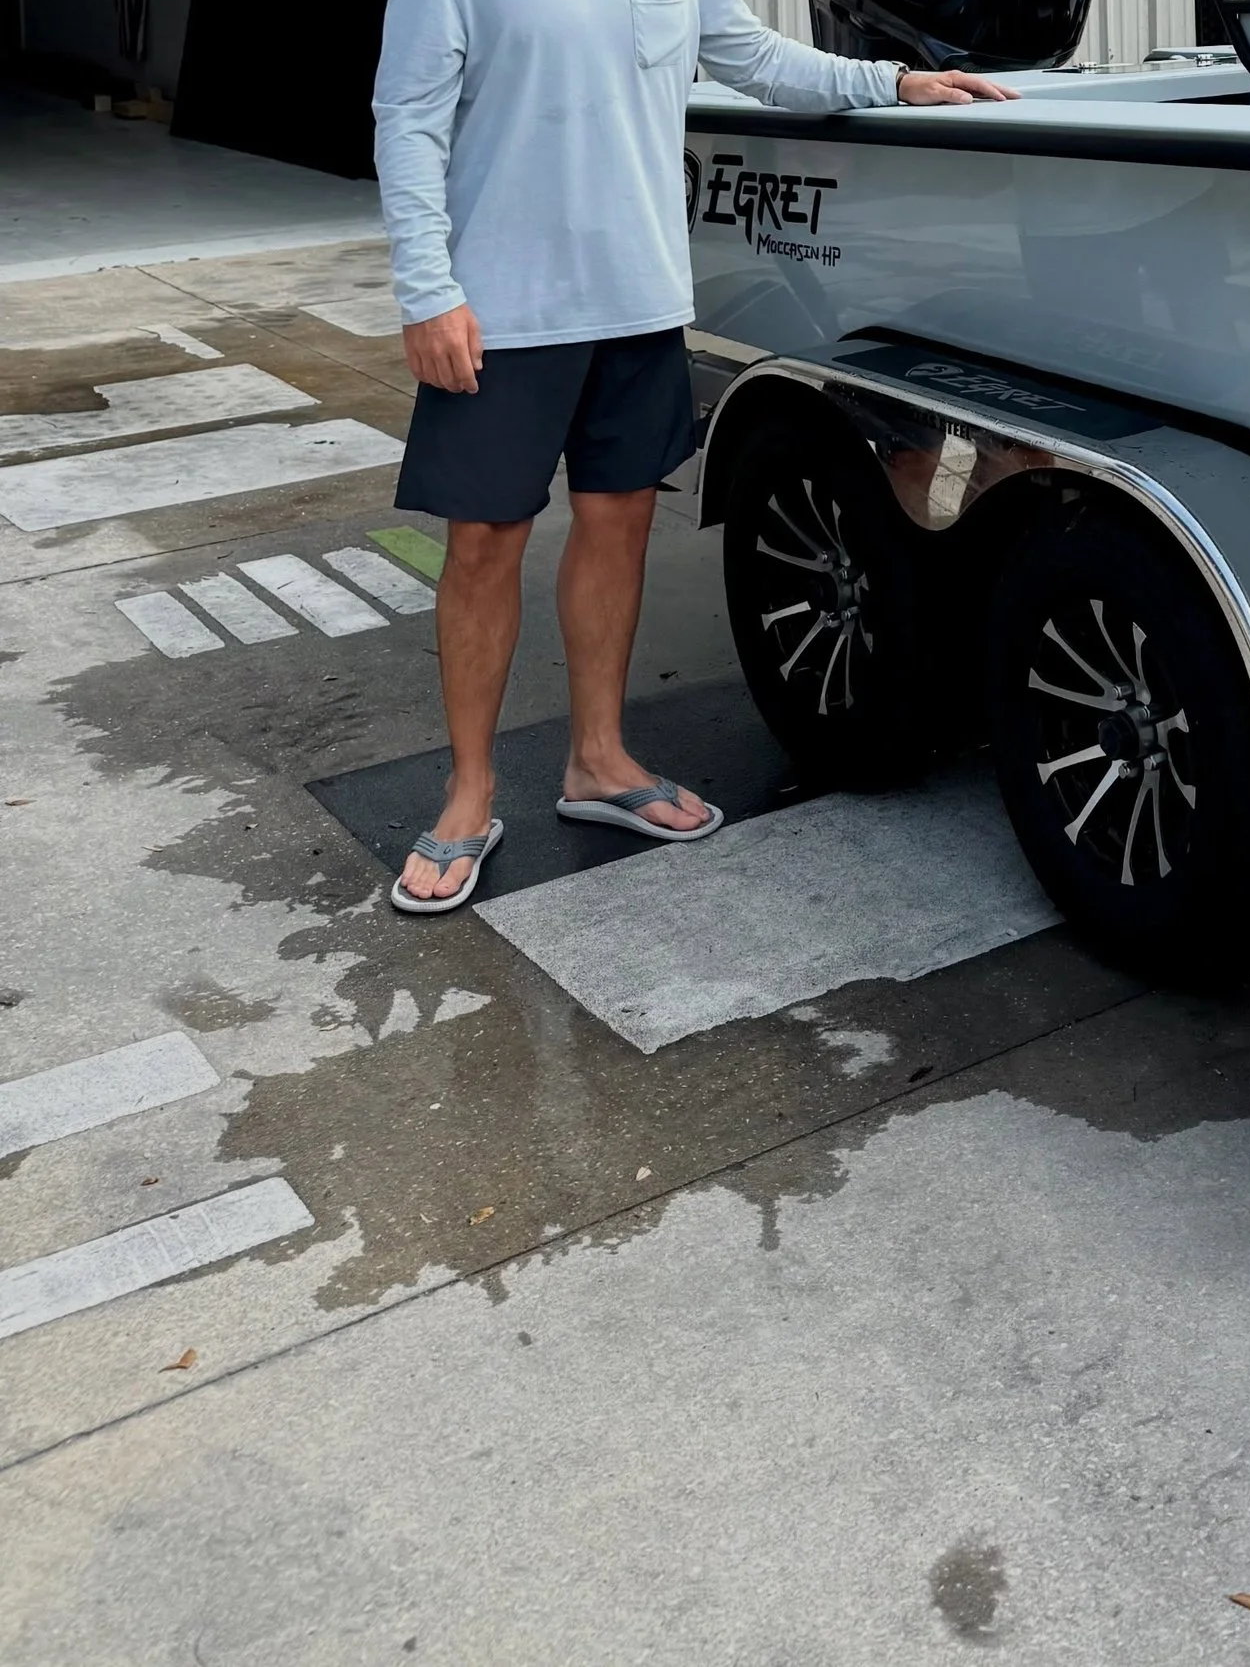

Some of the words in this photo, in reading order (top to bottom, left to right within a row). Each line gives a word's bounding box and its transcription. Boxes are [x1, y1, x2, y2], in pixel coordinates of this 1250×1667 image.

[702, 153, 838, 246] EGRET
[821, 245, 842, 267] HP
[929, 374, 1087, 412] EGRET
